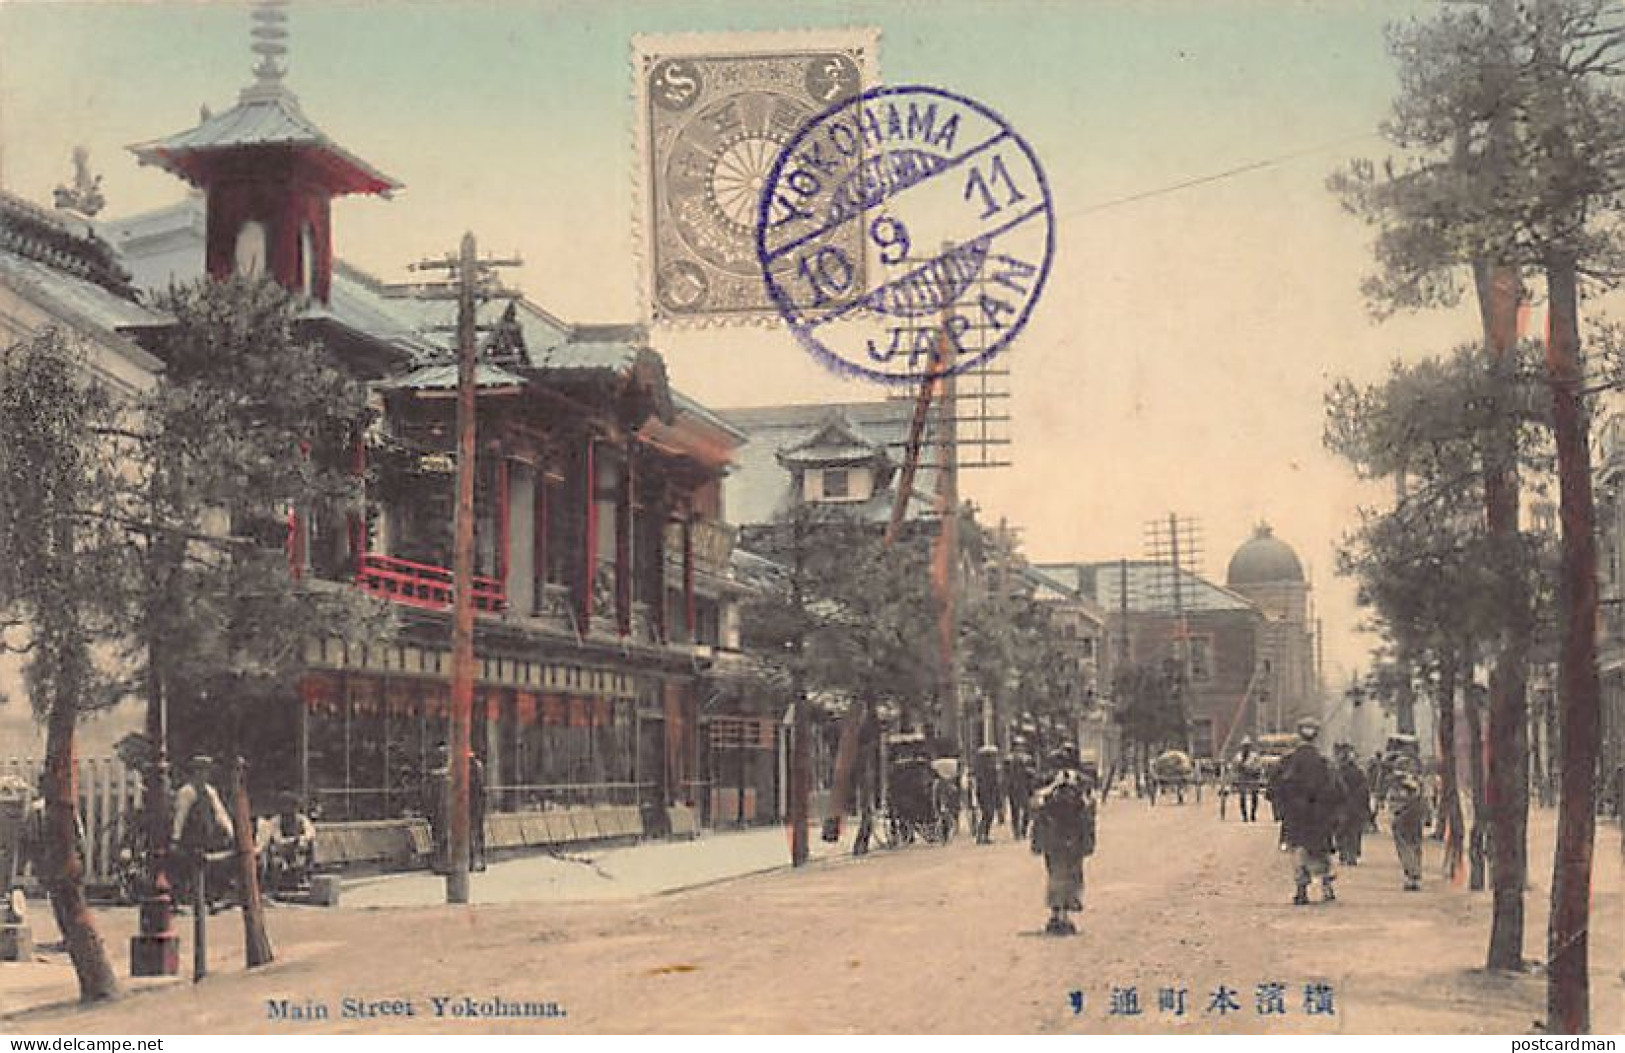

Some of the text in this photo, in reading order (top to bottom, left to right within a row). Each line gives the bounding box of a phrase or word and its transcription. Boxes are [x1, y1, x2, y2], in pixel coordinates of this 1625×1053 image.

[769, 102, 961, 229] YOKOHAMA
[799, 155, 1027, 308] 10 9 11
[867, 255, 1038, 369] JAPAN
